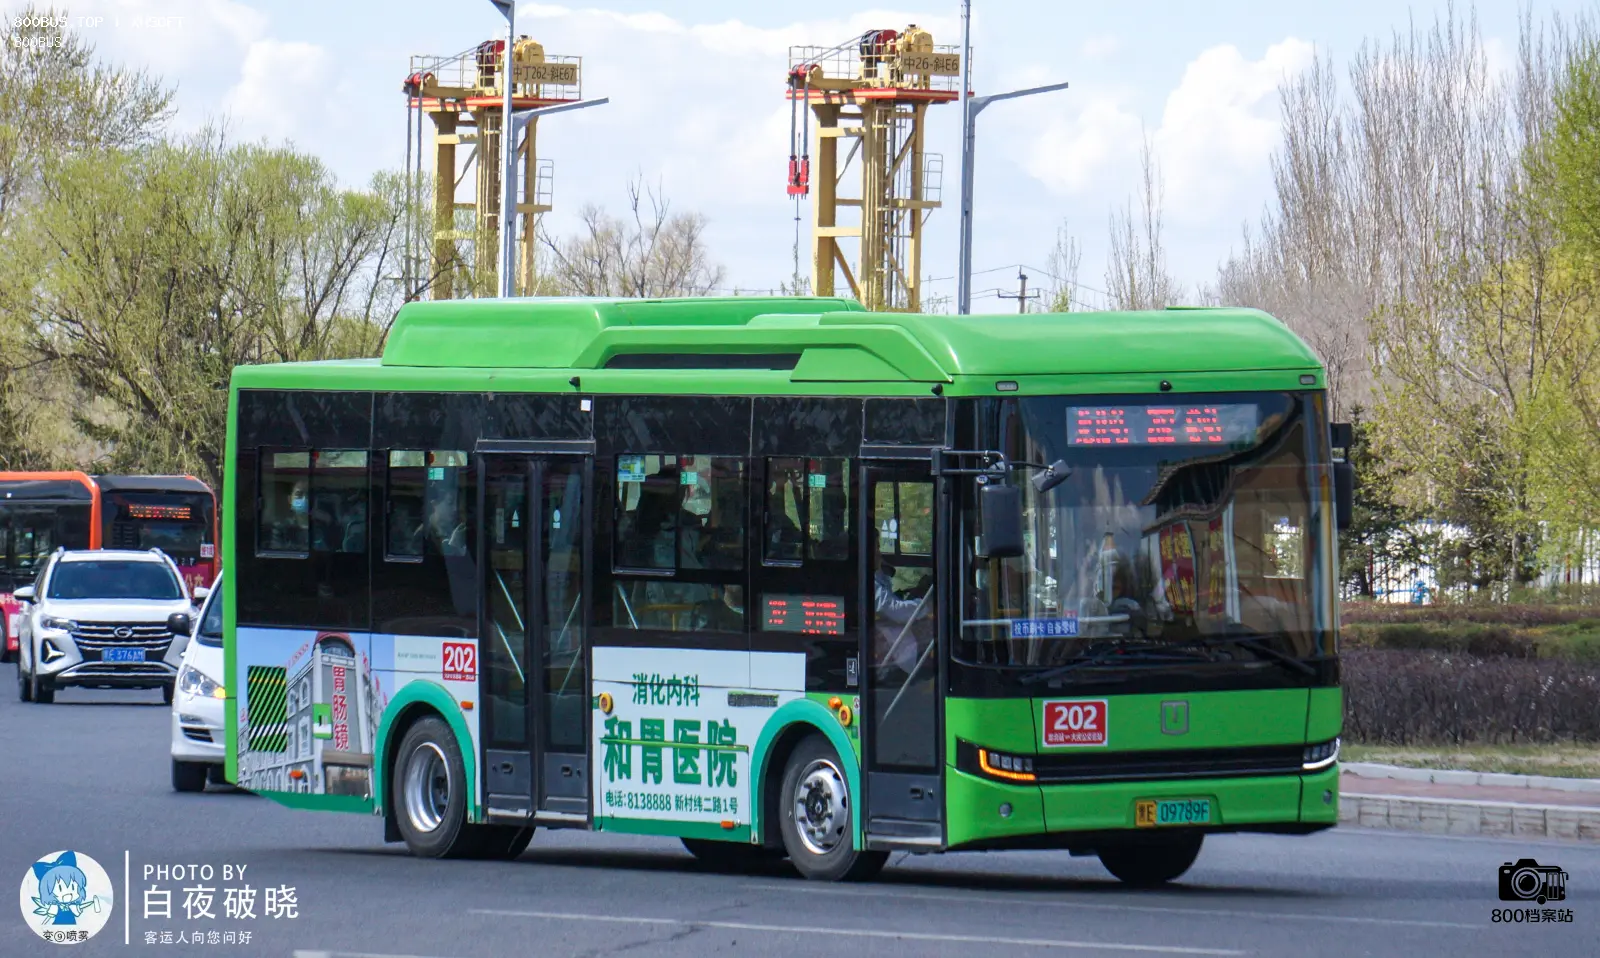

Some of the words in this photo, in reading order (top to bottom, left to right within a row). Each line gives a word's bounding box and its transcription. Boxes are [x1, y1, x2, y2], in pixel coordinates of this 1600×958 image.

[904, 57, 958, 72] 中26-斜E6
[444, 645, 474, 673] 202
[632, 672, 700, 707] 消化内科
[332, 665, 349, 750] 胃肠镜
[1053, 704, 1098, 731] 202
[603, 715, 738, 788] 和胃医院
[605, 789, 672, 812] 电话:8138888
[674, 794, 738, 815] 新村纬二路1号
